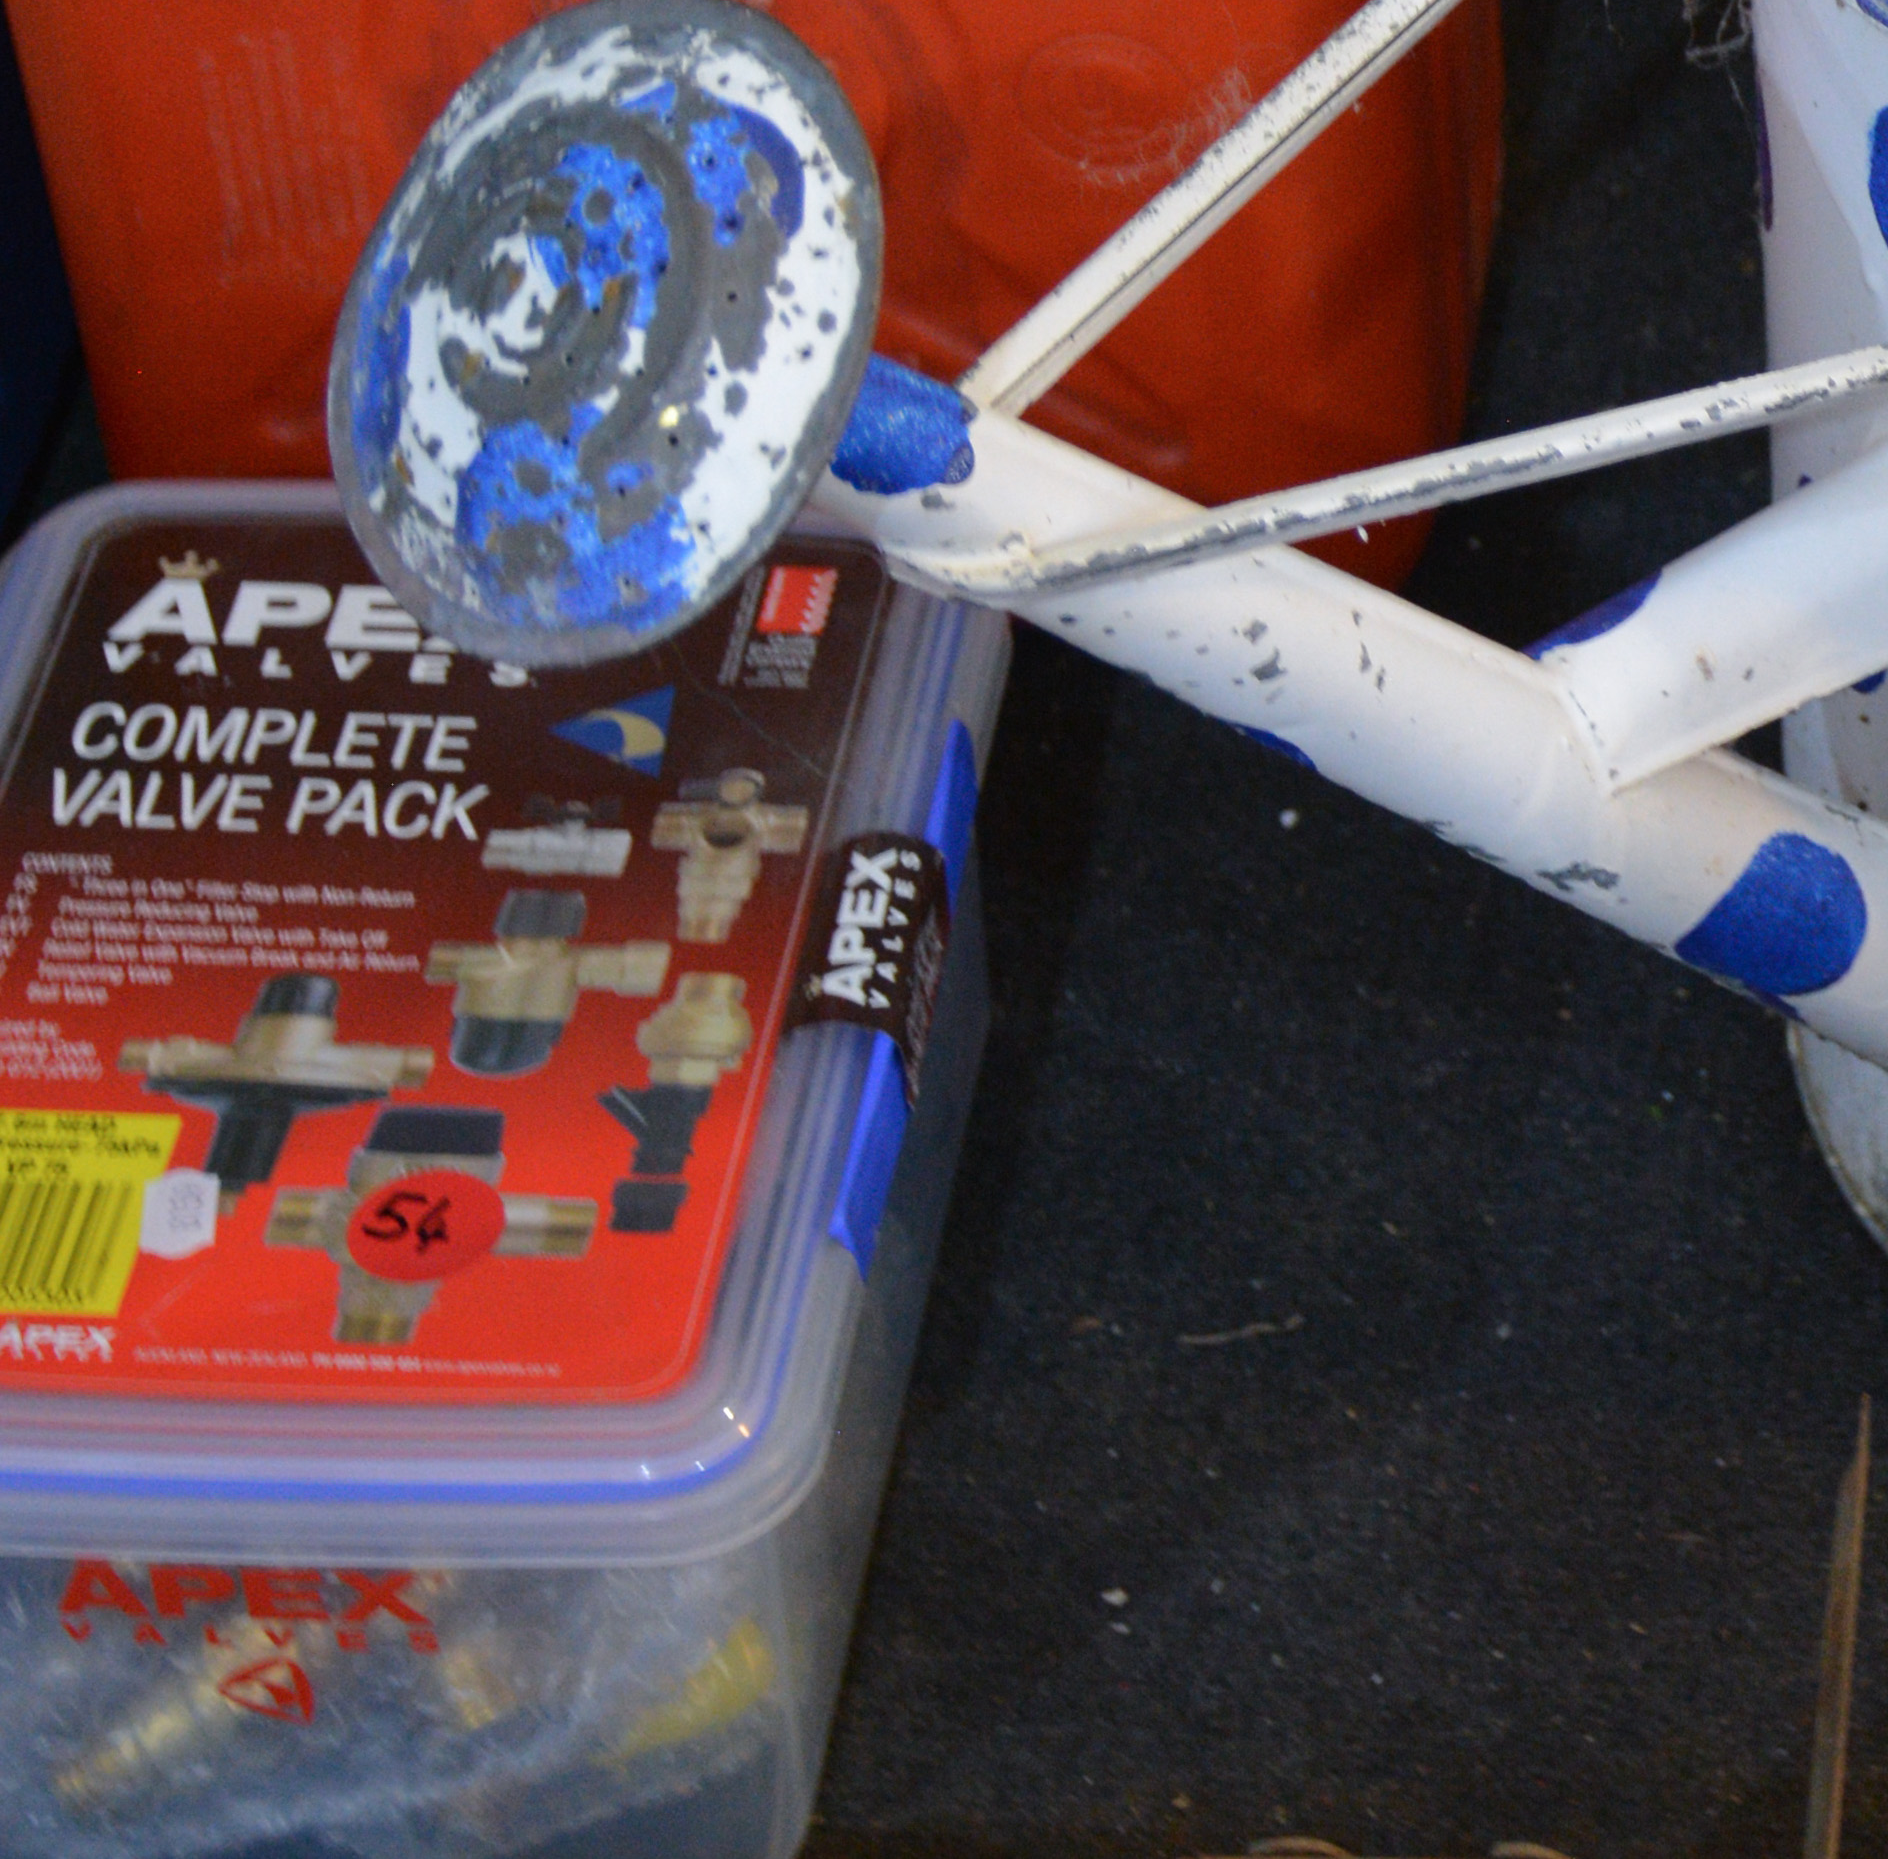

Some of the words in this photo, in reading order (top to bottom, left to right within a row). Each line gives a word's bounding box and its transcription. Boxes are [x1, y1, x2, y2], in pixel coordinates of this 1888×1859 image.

[107, 578, 460, 654] APE
[71, 700, 477, 774] COMPLETE
[51, 767, 273, 834] VALVE
[286, 775, 490, 841] PACK
[821, 847, 899, 1008] APEX
[866, 849, 922, 1009] VALVES
[59, 1555, 434, 1625] APEX
